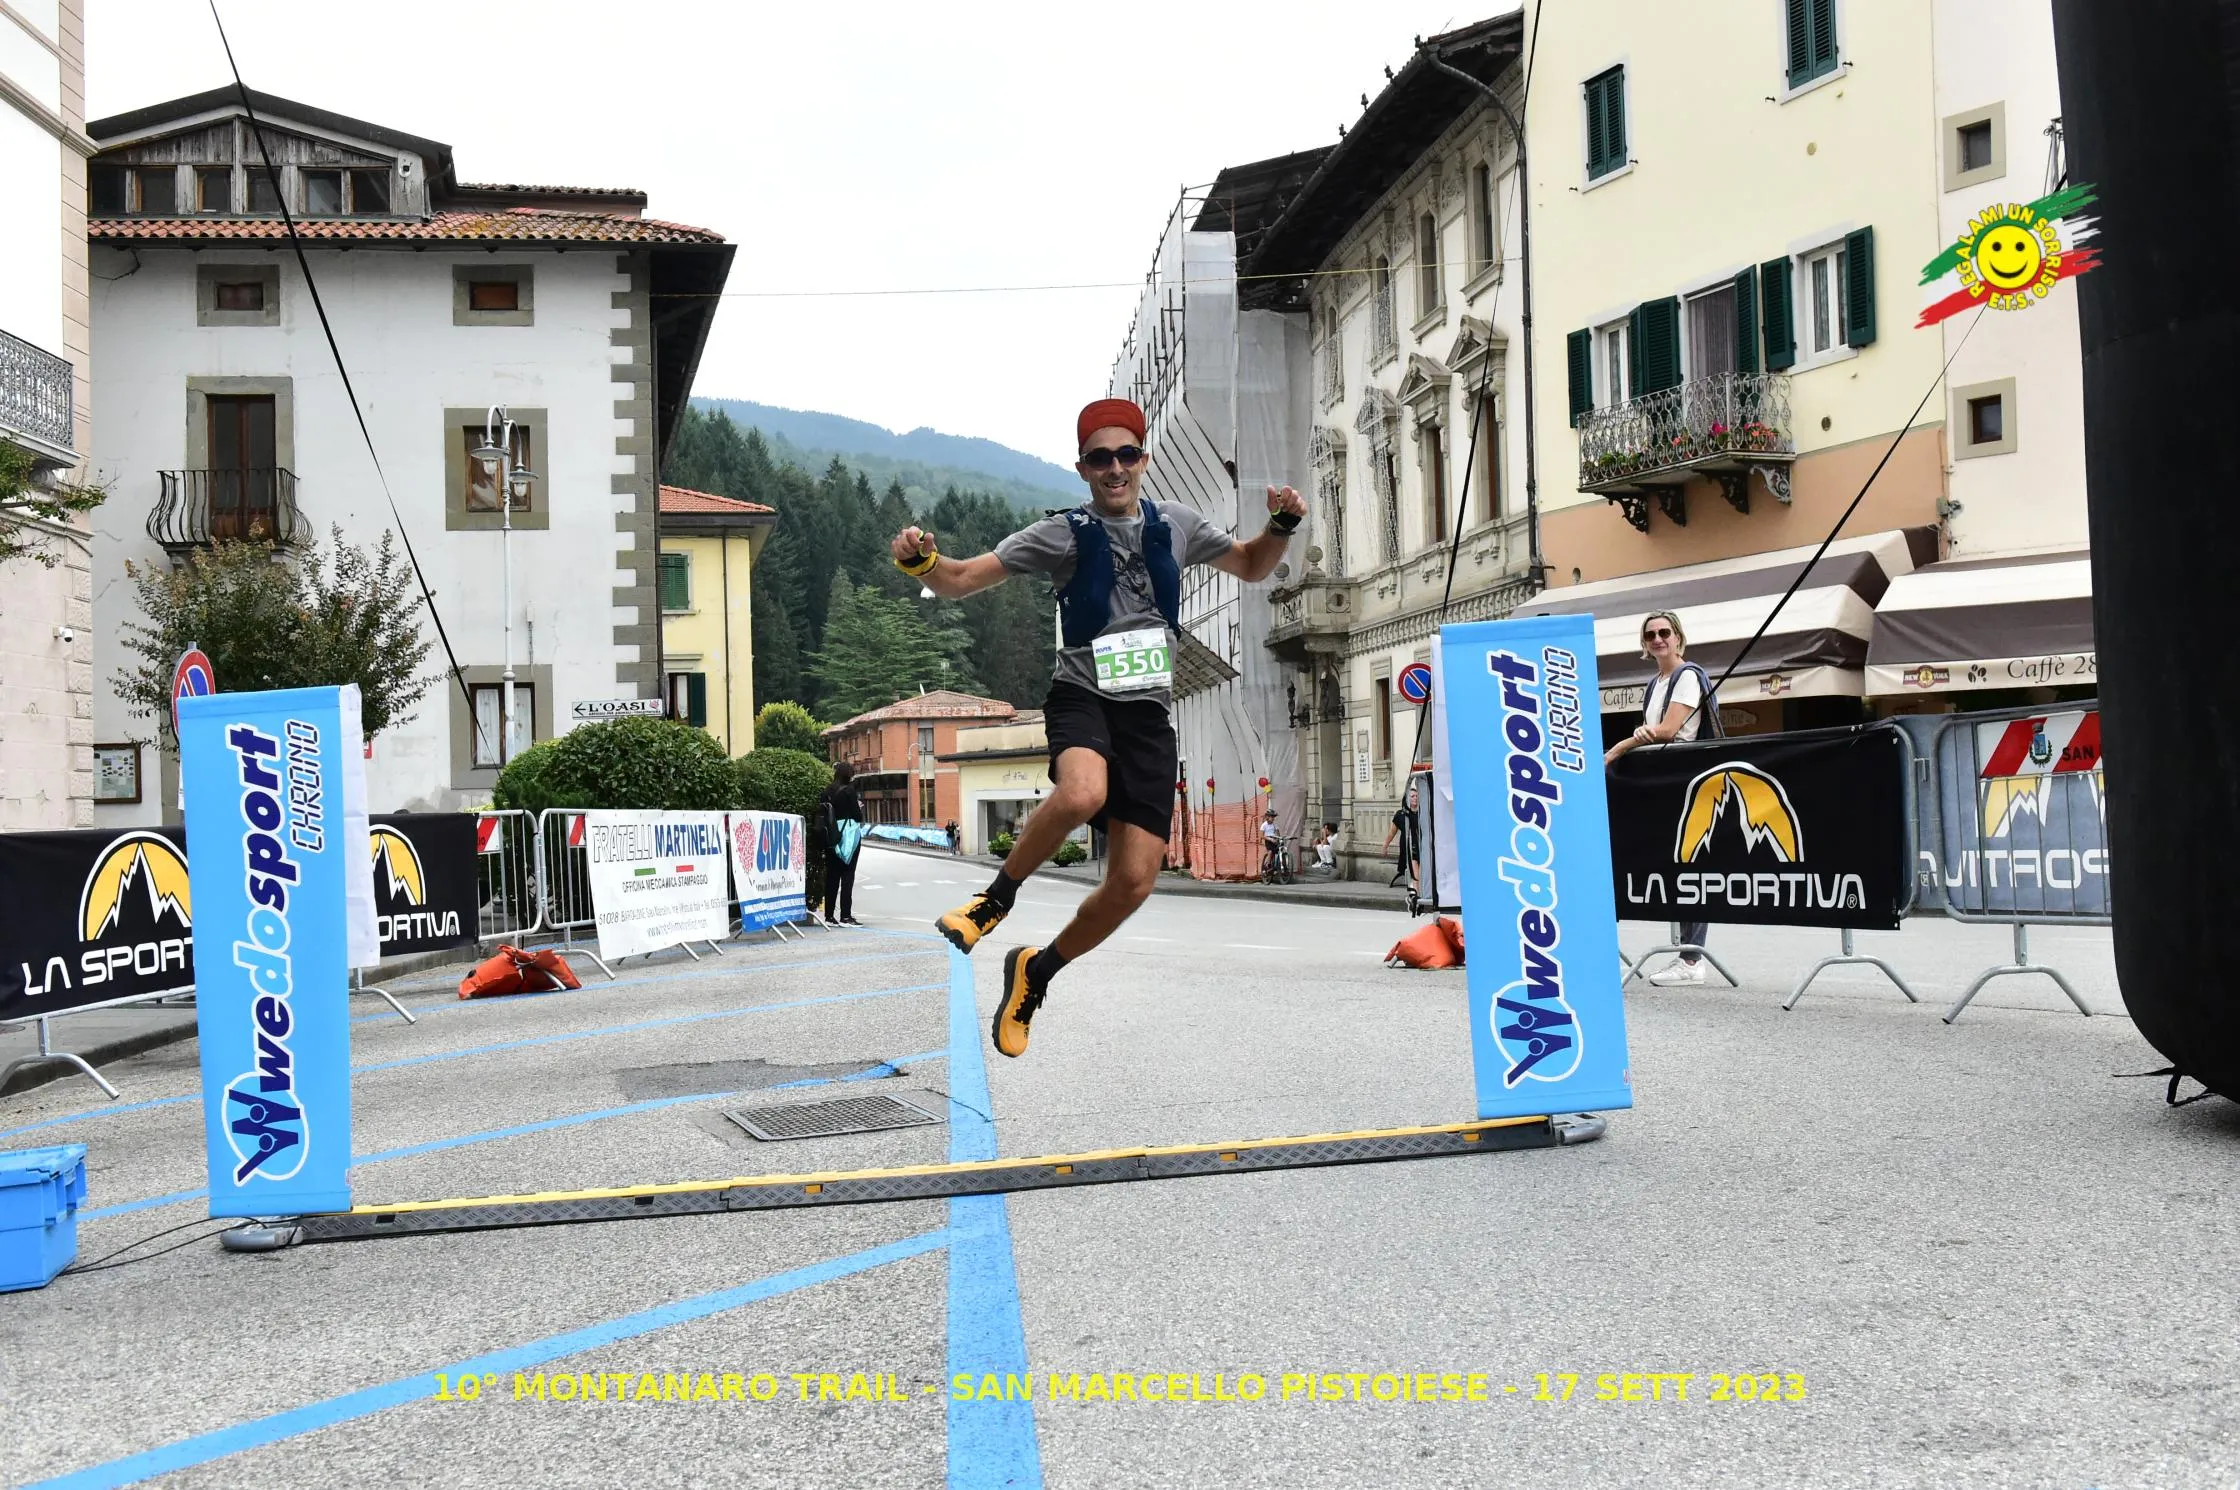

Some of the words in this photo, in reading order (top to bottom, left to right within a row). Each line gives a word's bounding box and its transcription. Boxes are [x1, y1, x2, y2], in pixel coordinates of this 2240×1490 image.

[1114, 648, 1164, 677] 550
[2007, 655, 2065, 683] Caffè
[588, 701, 646, 712] L'OASI
[1544, 647, 1583, 772] CHRONO
[1603, 687, 1634, 710] Caffè
[2062, 744, 2095, 762] SAN
[287, 720, 323, 851] CHRONO
[592, 824, 653, 863] FRATELLI
[654, 824, 722, 858] MARTINELLI
[1489, 650, 1560, 1000] wedosport
[757, 818, 791, 873] AVIS
[228, 725, 298, 1094] wedosport
[1627, 873, 1667, 904] LA
[1676, 873, 1866, 909] SPORTIVA
[21, 956, 72, 995] LA
